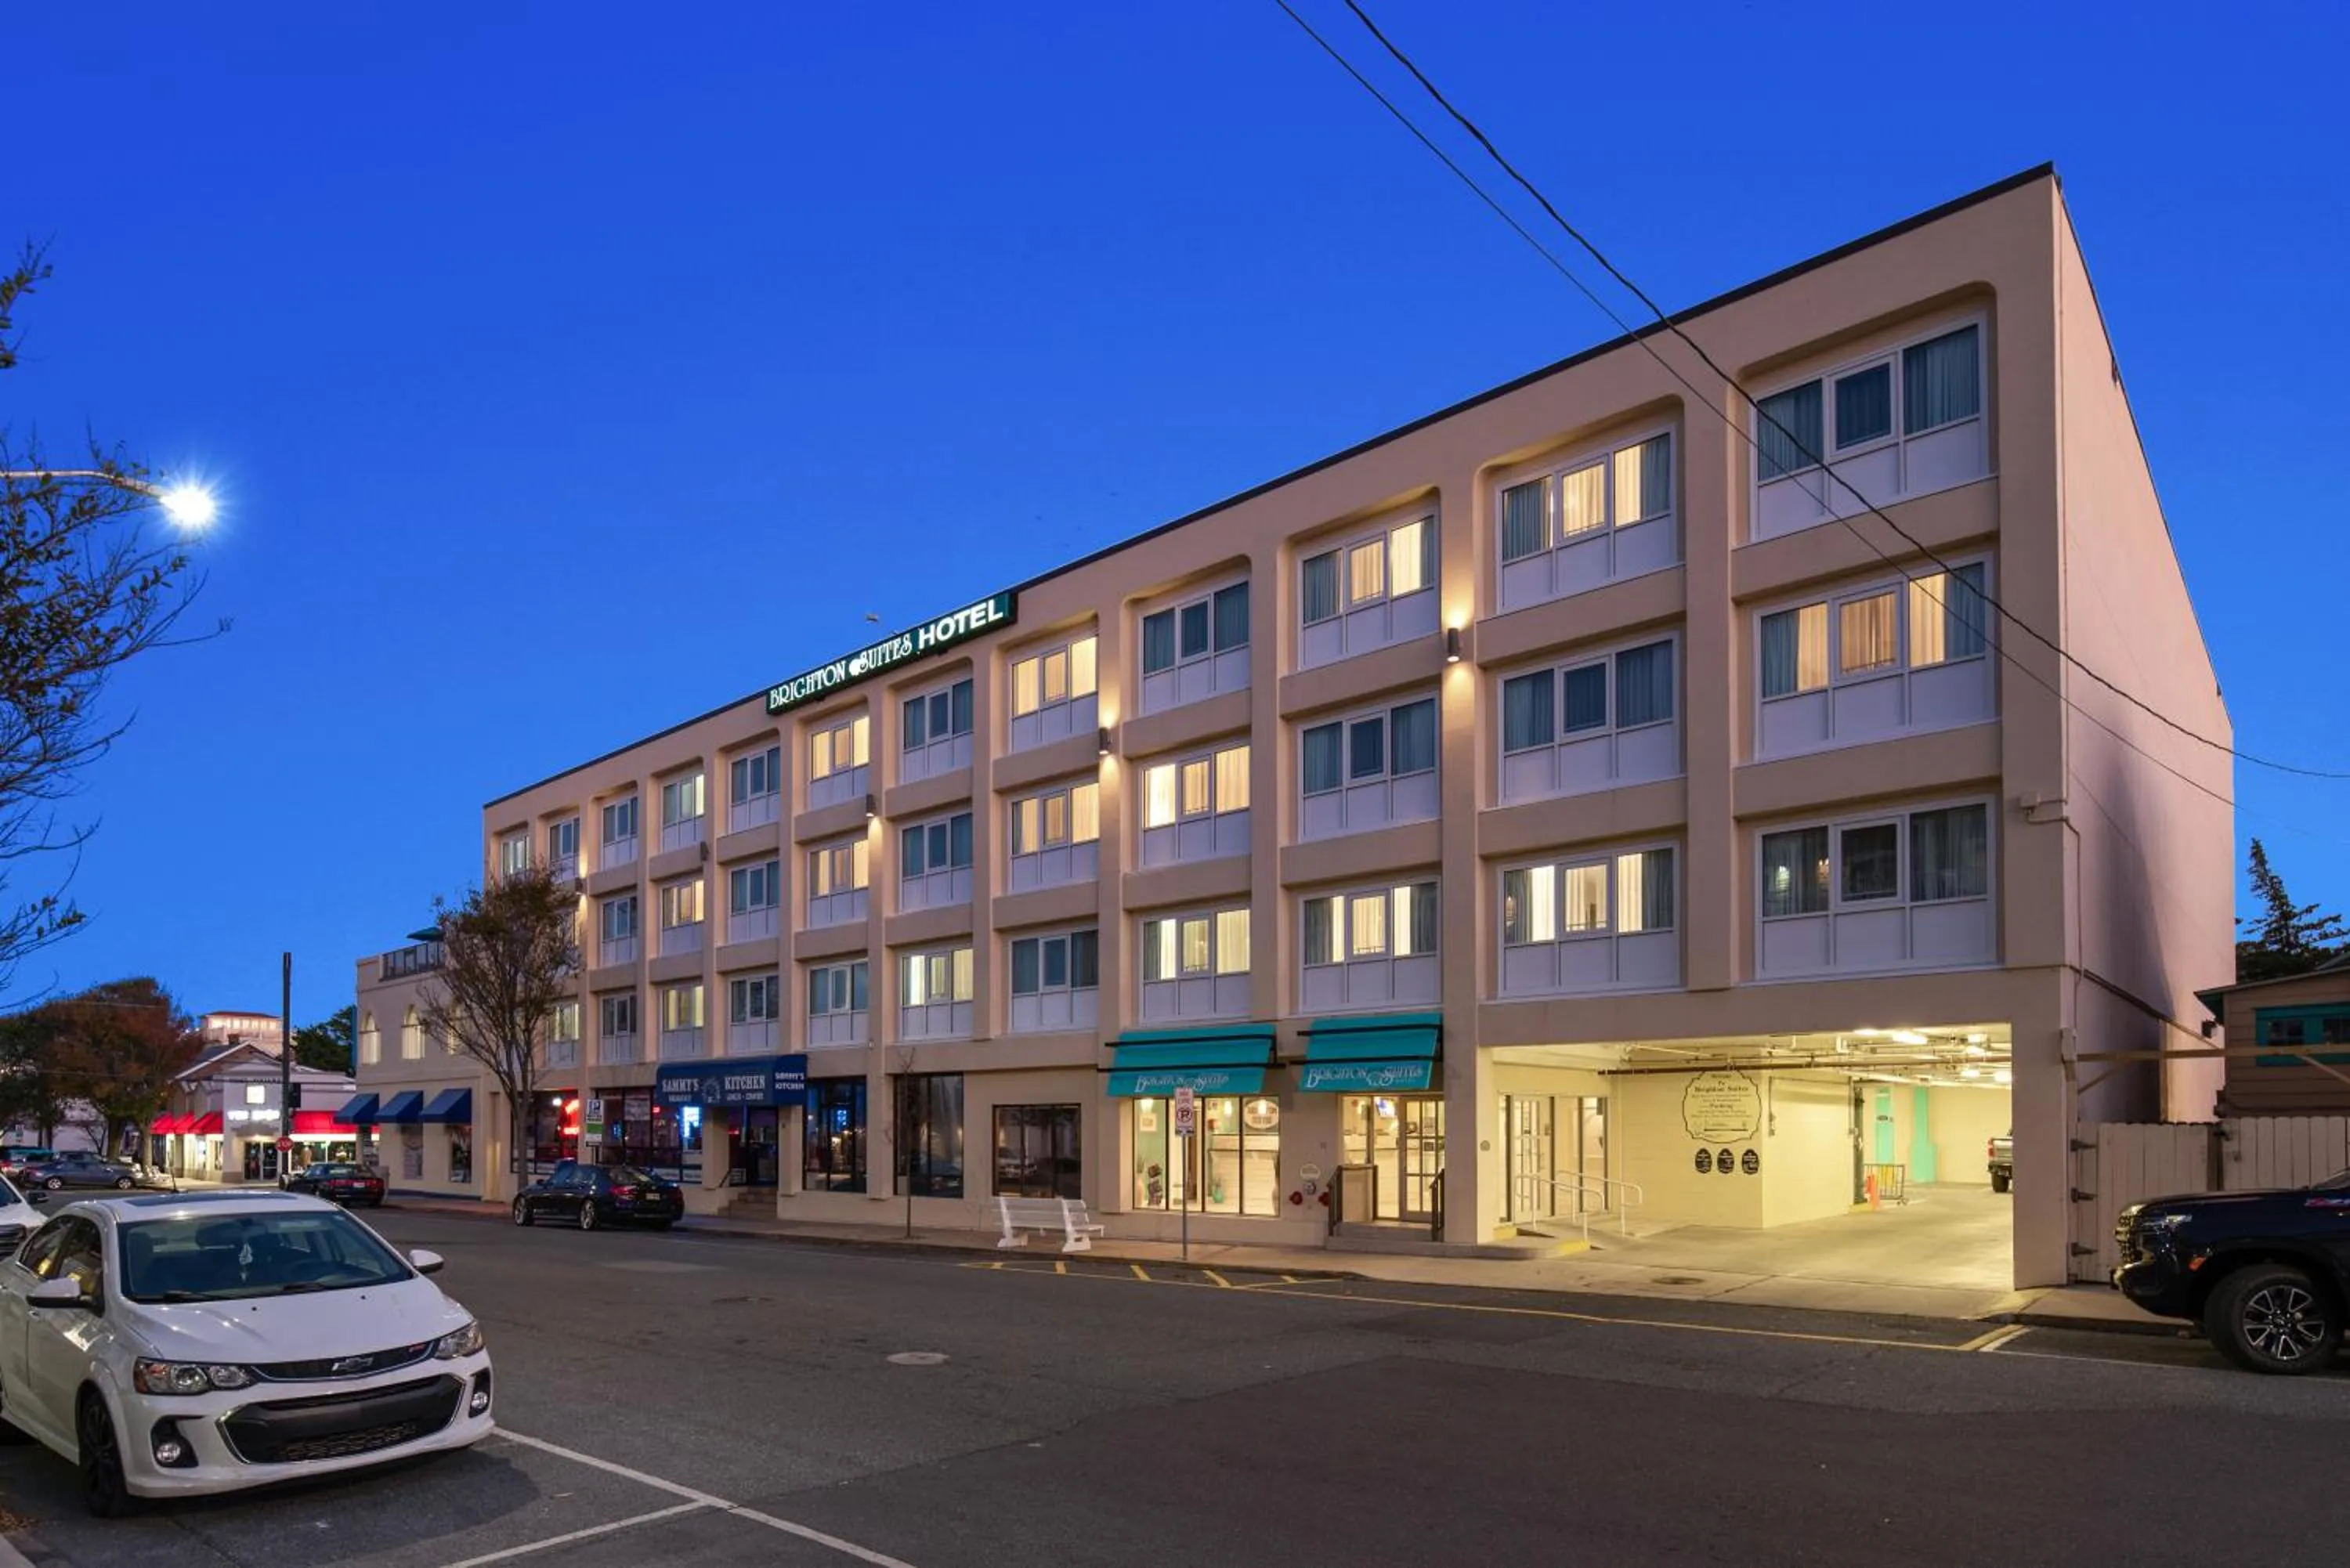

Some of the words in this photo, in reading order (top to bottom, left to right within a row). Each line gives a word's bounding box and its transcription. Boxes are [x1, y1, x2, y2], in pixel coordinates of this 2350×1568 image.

[770, 660, 847, 710] BRIGHTON
[859, 633, 913, 674] SUITES
[919, 599, 1003, 650] HOTEL
[662, 1078, 700, 1093] SAMMY'S
[725, 1075, 765, 1090] KITCHEN
[774, 1081, 805, 1090] KITCHEN
[1307, 1067, 1368, 1088] BRIGHTON
[1379, 1065, 1424, 1087] SUITES
